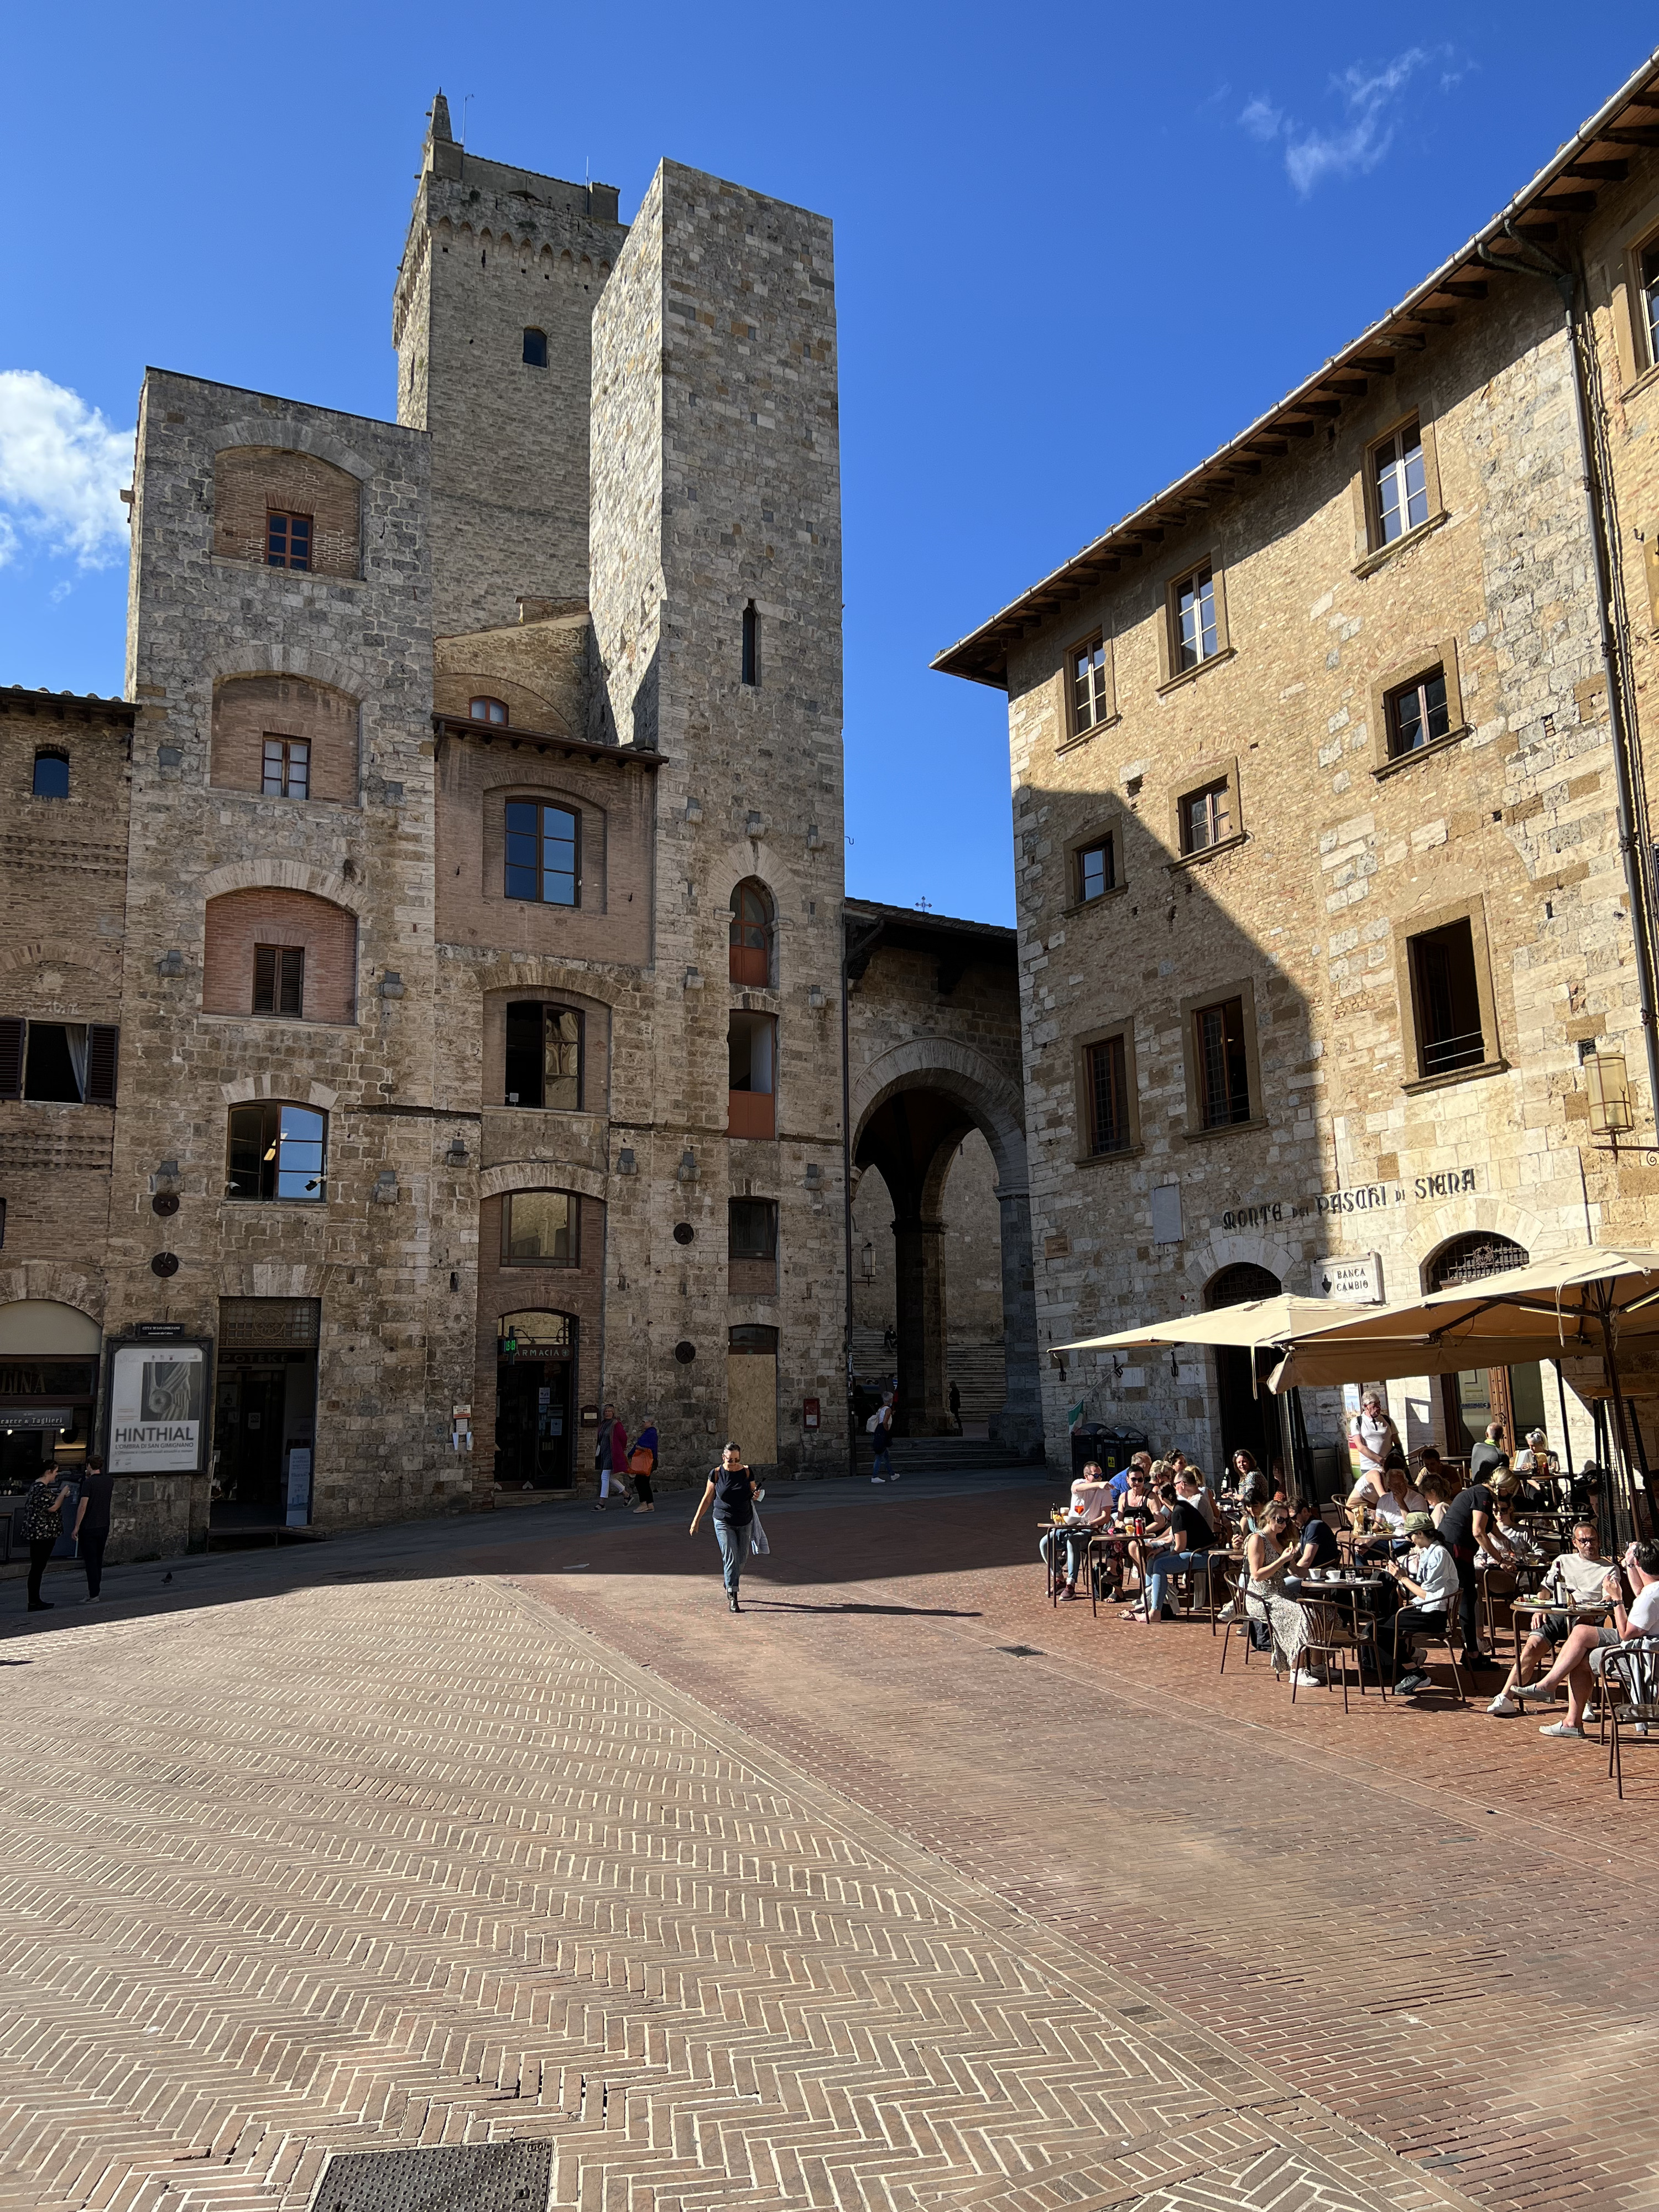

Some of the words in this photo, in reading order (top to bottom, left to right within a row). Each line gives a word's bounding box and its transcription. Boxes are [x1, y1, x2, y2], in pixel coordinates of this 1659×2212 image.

[1223, 1203, 1282, 1229] MONTE
[1315, 1186, 1387, 1216] PASCHI
[1415, 1168, 1476, 1199] SIENA
[1337, 1267, 1366, 1279] BANCA
[1337, 1280, 1368, 1292] CAMBIO
[221, 1354, 288, 1363] POTEKE
[115, 1426, 194, 1443] HINTHIAL
